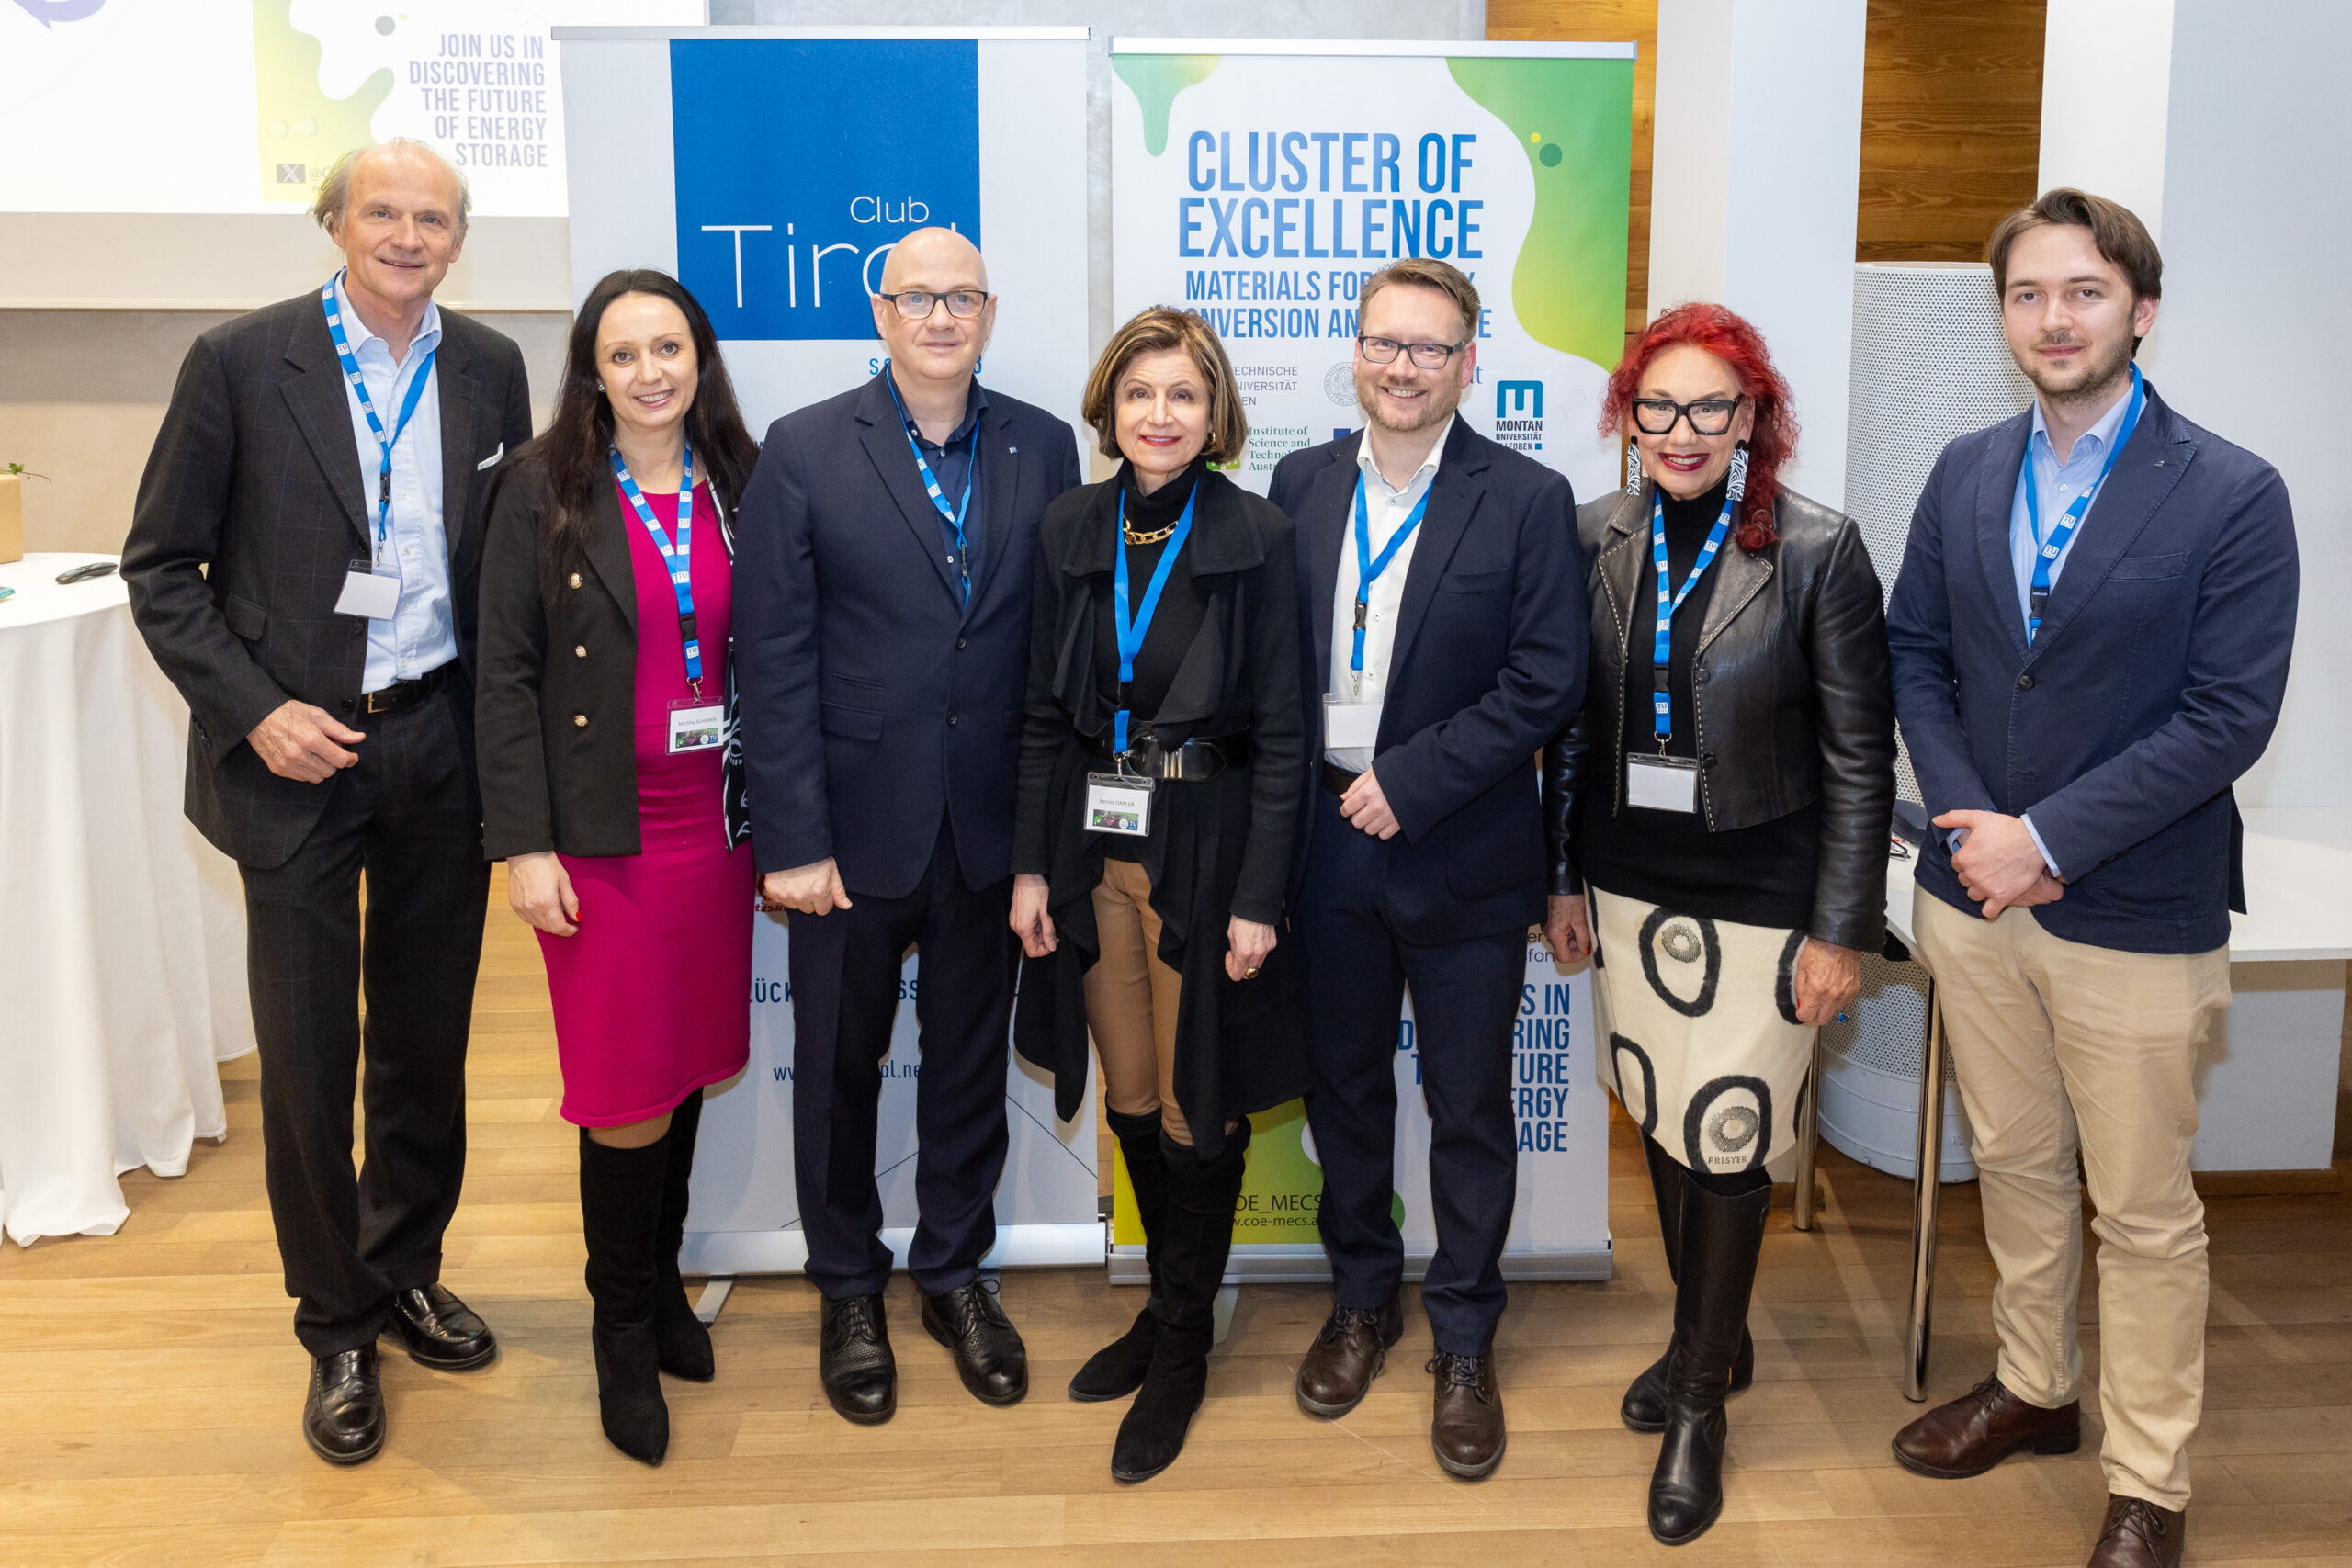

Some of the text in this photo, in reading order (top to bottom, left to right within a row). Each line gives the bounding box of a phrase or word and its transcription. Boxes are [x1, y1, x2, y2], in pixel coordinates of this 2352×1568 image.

[438, 33, 544, 59] JOIN US IN
[409, 61, 545, 86] DISCOVERING
[421, 88, 547, 113] THE FUTURE
[435, 116, 547, 141] OF ENERGY
[455, 142, 548, 167] STORAGE
[1188, 130, 1476, 193] CLUSTER OF
[850, 196, 930, 223] Club
[1179, 197, 1484, 259] EXCELLENCE
[701, 222, 956, 308] Tir
[1185, 270, 1321, 301] MATERIALS
[1171, 308, 1360, 338] NVERSION AN
[1231, 366, 1298, 377] ECHNISCHE
[1236, 379, 1298, 391] NIVERSITÄT
[1249, 425, 1309, 436] Institute of
[1496, 420, 1544, 432] MONTAN
[1496, 431, 1543, 441] UNIVERSITÄT
[1248, 449, 1291, 460] Techno
[1249, 437, 1311, 448] Science and
[1248, 462, 1276, 471] Aust
[2047, 545, 2058, 556] TU
[1545, 983, 1570, 1015] IN
[1235, 1194, 1322, 1213] OE_MECS
